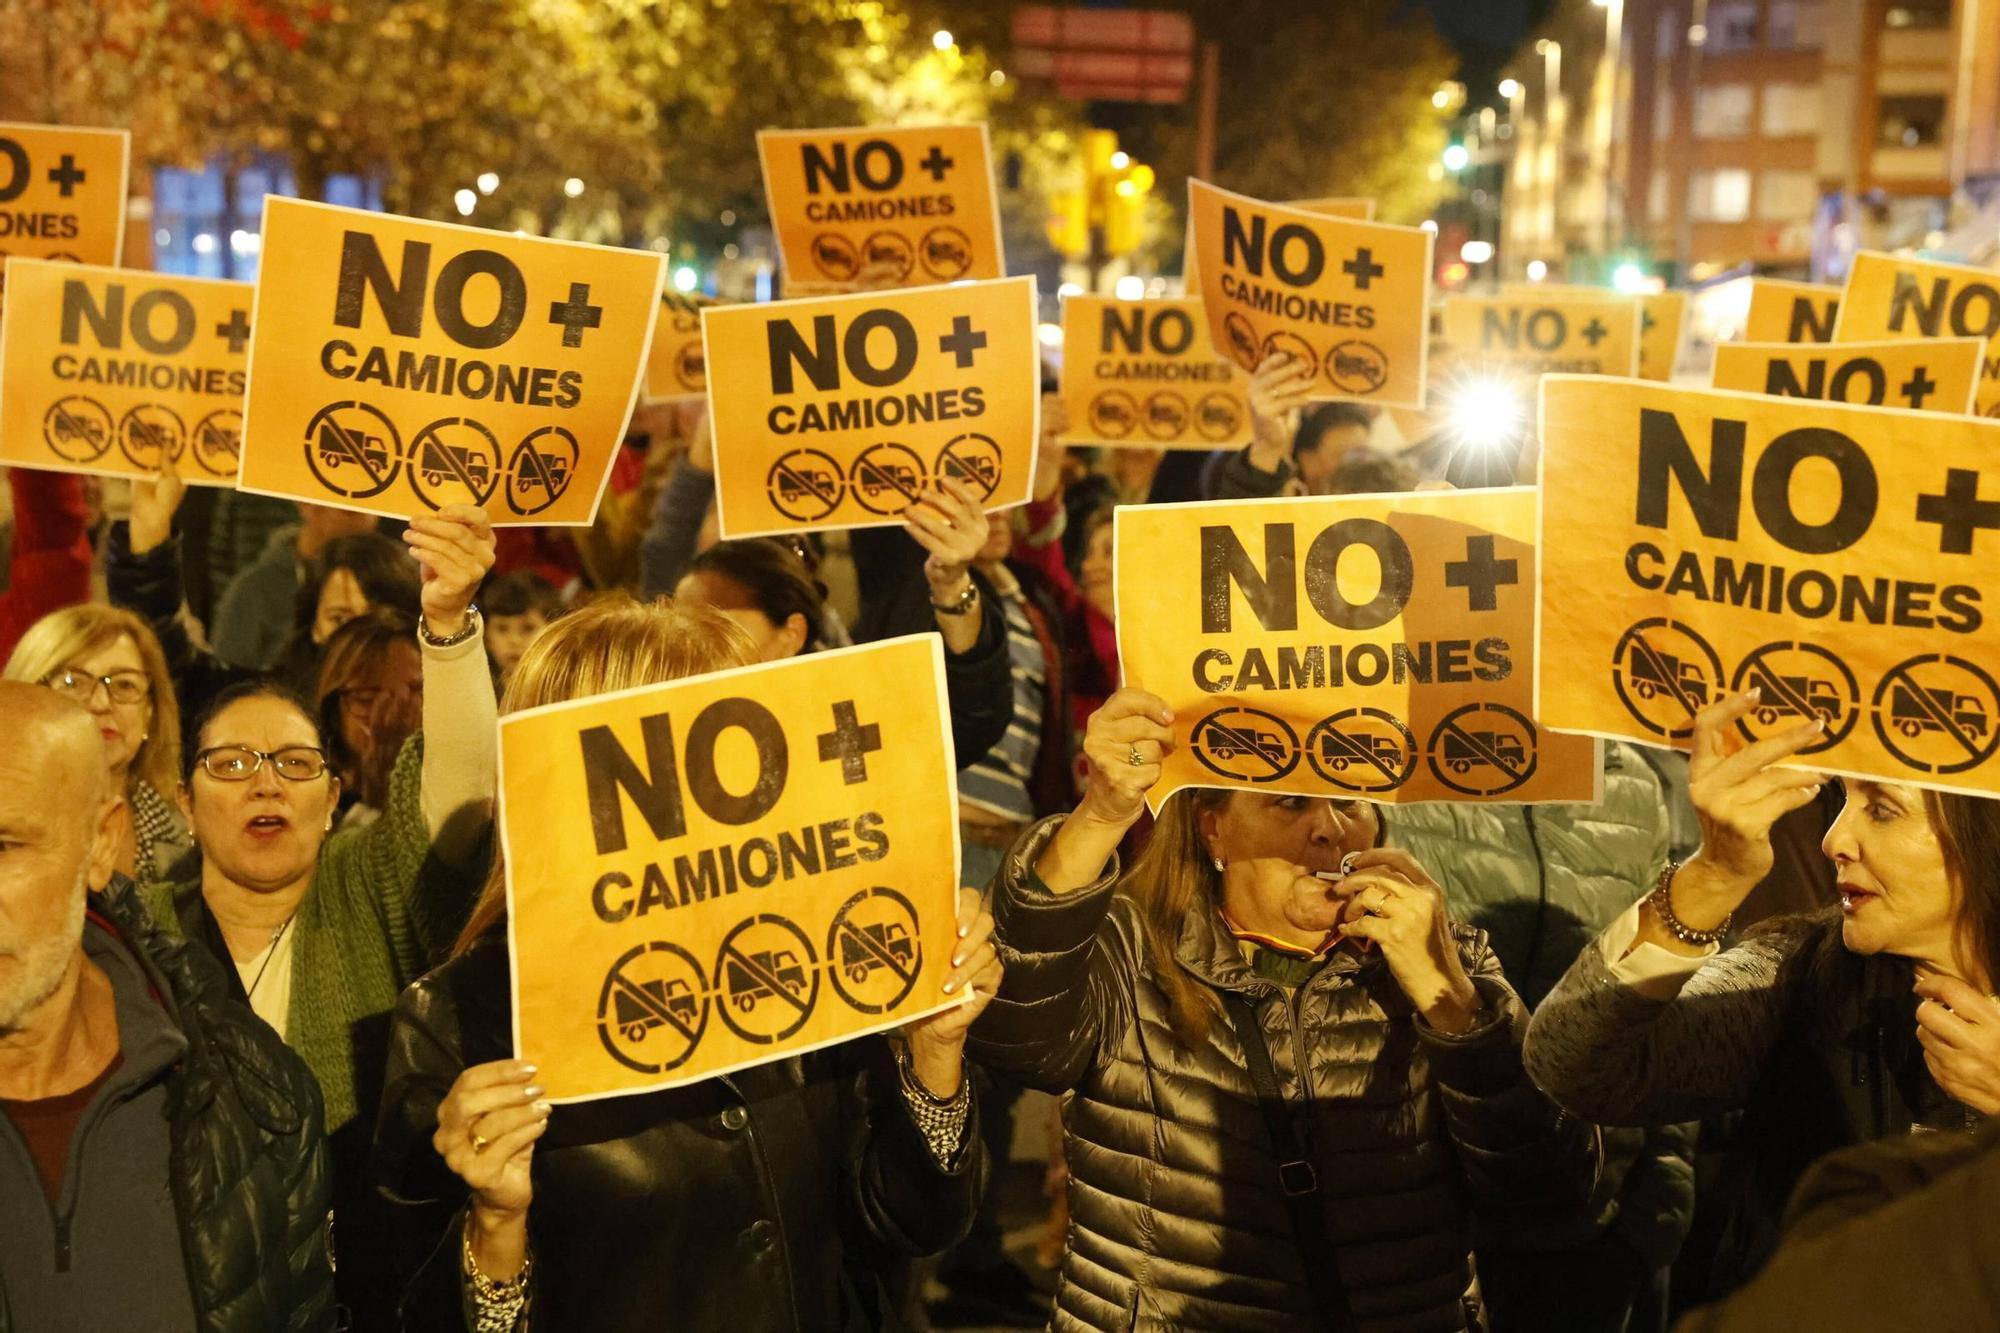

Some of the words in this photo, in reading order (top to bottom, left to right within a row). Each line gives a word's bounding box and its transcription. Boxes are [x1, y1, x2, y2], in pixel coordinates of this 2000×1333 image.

[800, 139, 905, 194] NO
[920, 146, 954, 182] +
[805, 195, 955, 223] CAMIONES
[1222, 206, 1326, 287] NO
[1343, 247, 1384, 290] +
[60, 279, 196, 356] NO
[333, 229, 527, 349] NO
[549, 282, 602, 348] +
[1220, 272, 1375, 330] CAMIONES
[1788, 297, 1838, 343] N
[1888, 271, 2000, 337] NO
[766, 308, 919, 395] NO
[939, 315, 987, 369] +
[1101, 306, 1194, 356] NO
[1480, 308, 1567, 352] NO
[52, 354, 246, 396] CAMIONES
[321, 339, 582, 409] CAMIONES
[1094, 360, 1233, 383] CAMIONES
[1765, 357, 1886, 406] NO
[767, 386, 986, 436] CAMIONES
[1635, 407, 1879, 555] NO
[1200, 518, 1414, 634] NO
[1444, 535, 1518, 611] +
[1625, 541, 1984, 634] CAMIONES
[1192, 637, 1512, 693] CAMIONES
[578, 696, 789, 856] NO
[816, 699, 882, 786] +
[591, 811, 890, 923] CAMIONES
